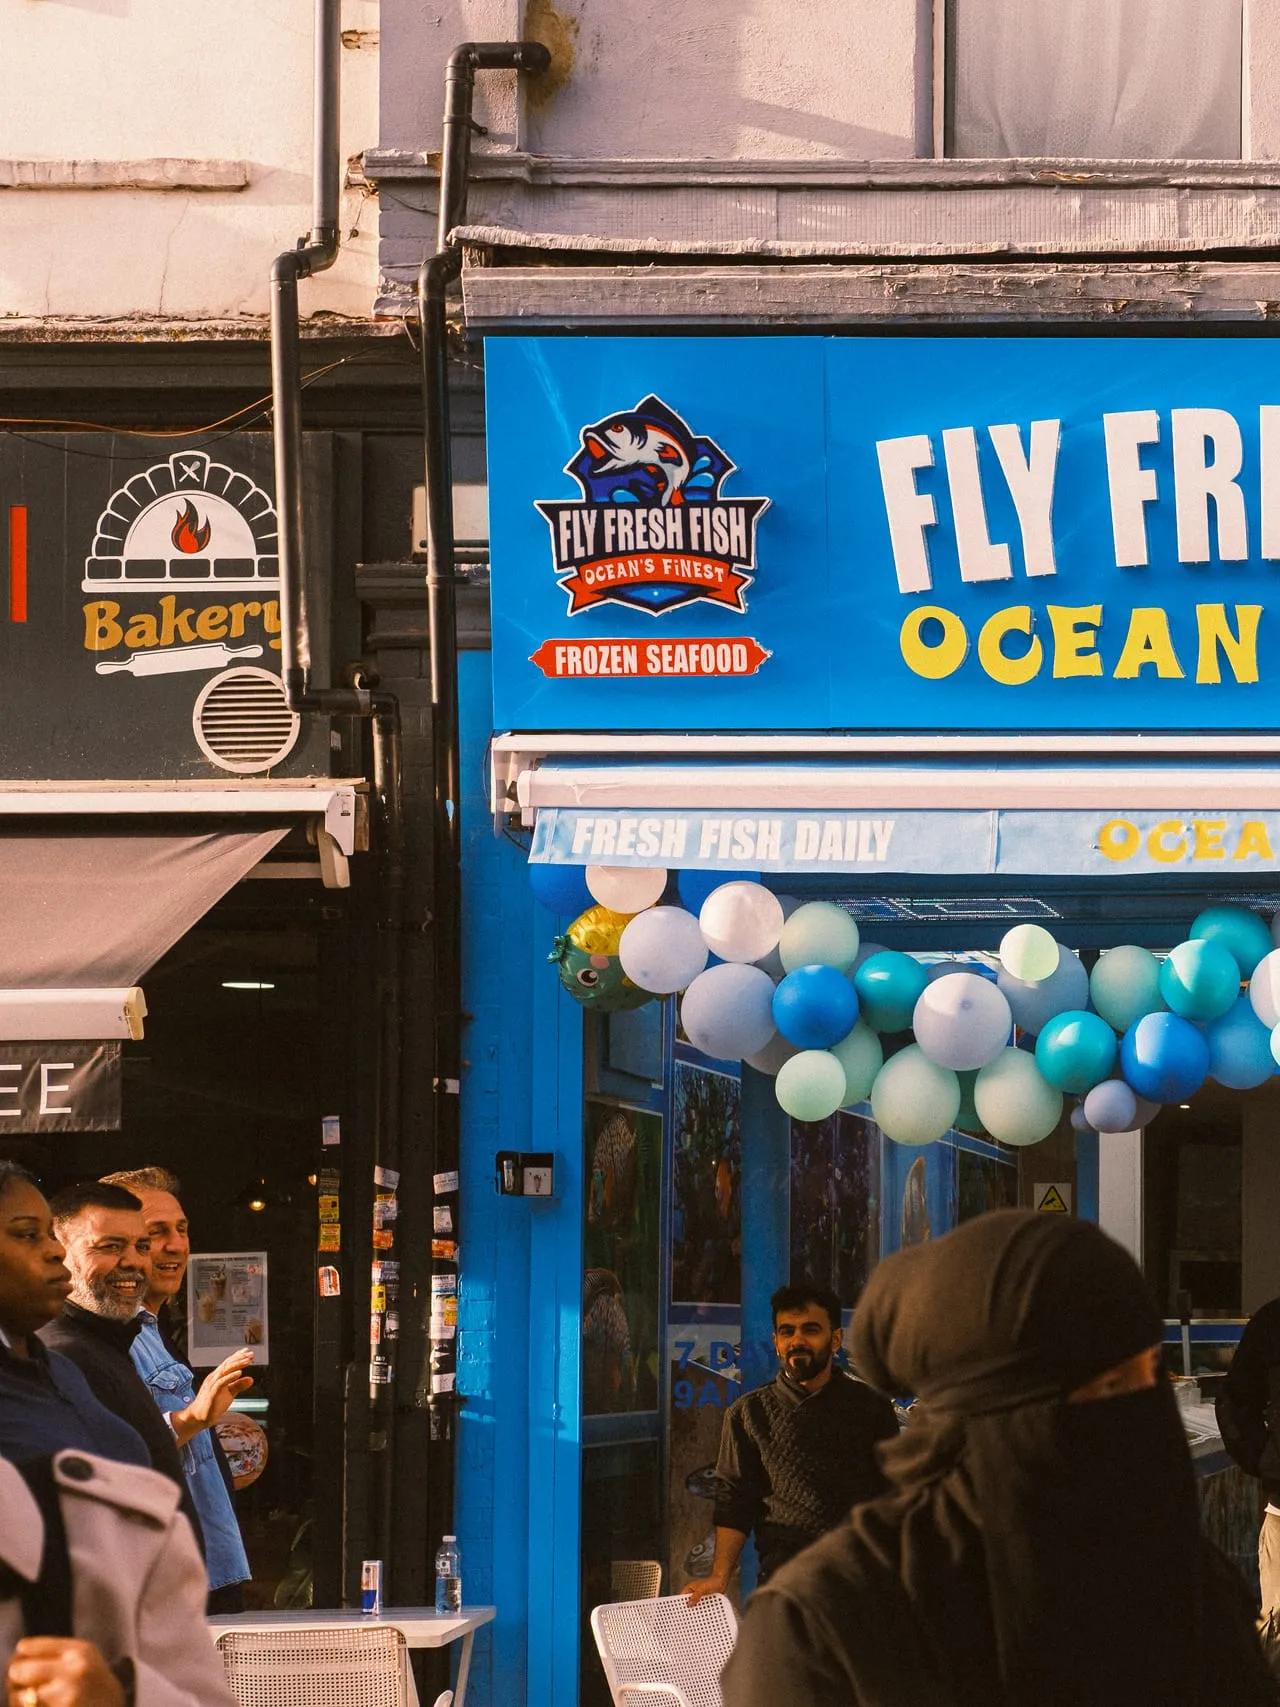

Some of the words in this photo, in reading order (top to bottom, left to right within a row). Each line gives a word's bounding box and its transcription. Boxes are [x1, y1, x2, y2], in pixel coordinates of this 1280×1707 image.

[876, 419, 1060, 593] FLY
[558, 509, 597, 562] FLY
[603, 507, 683, 553] FRESH
[689, 506, 747, 559] FISH
[585, 557, 655, 585] OCEAN'S
[82, 594, 282, 651] Bakery
[555, 645, 637, 675] FROZEN
[646, 643, 748, 673] SEAFOOD
[571, 818, 688, 857] FRESH
[698, 819, 784, 860] FISH
[793, 820, 896, 862] DAILY
[674, 1341, 695, 1370] 7
